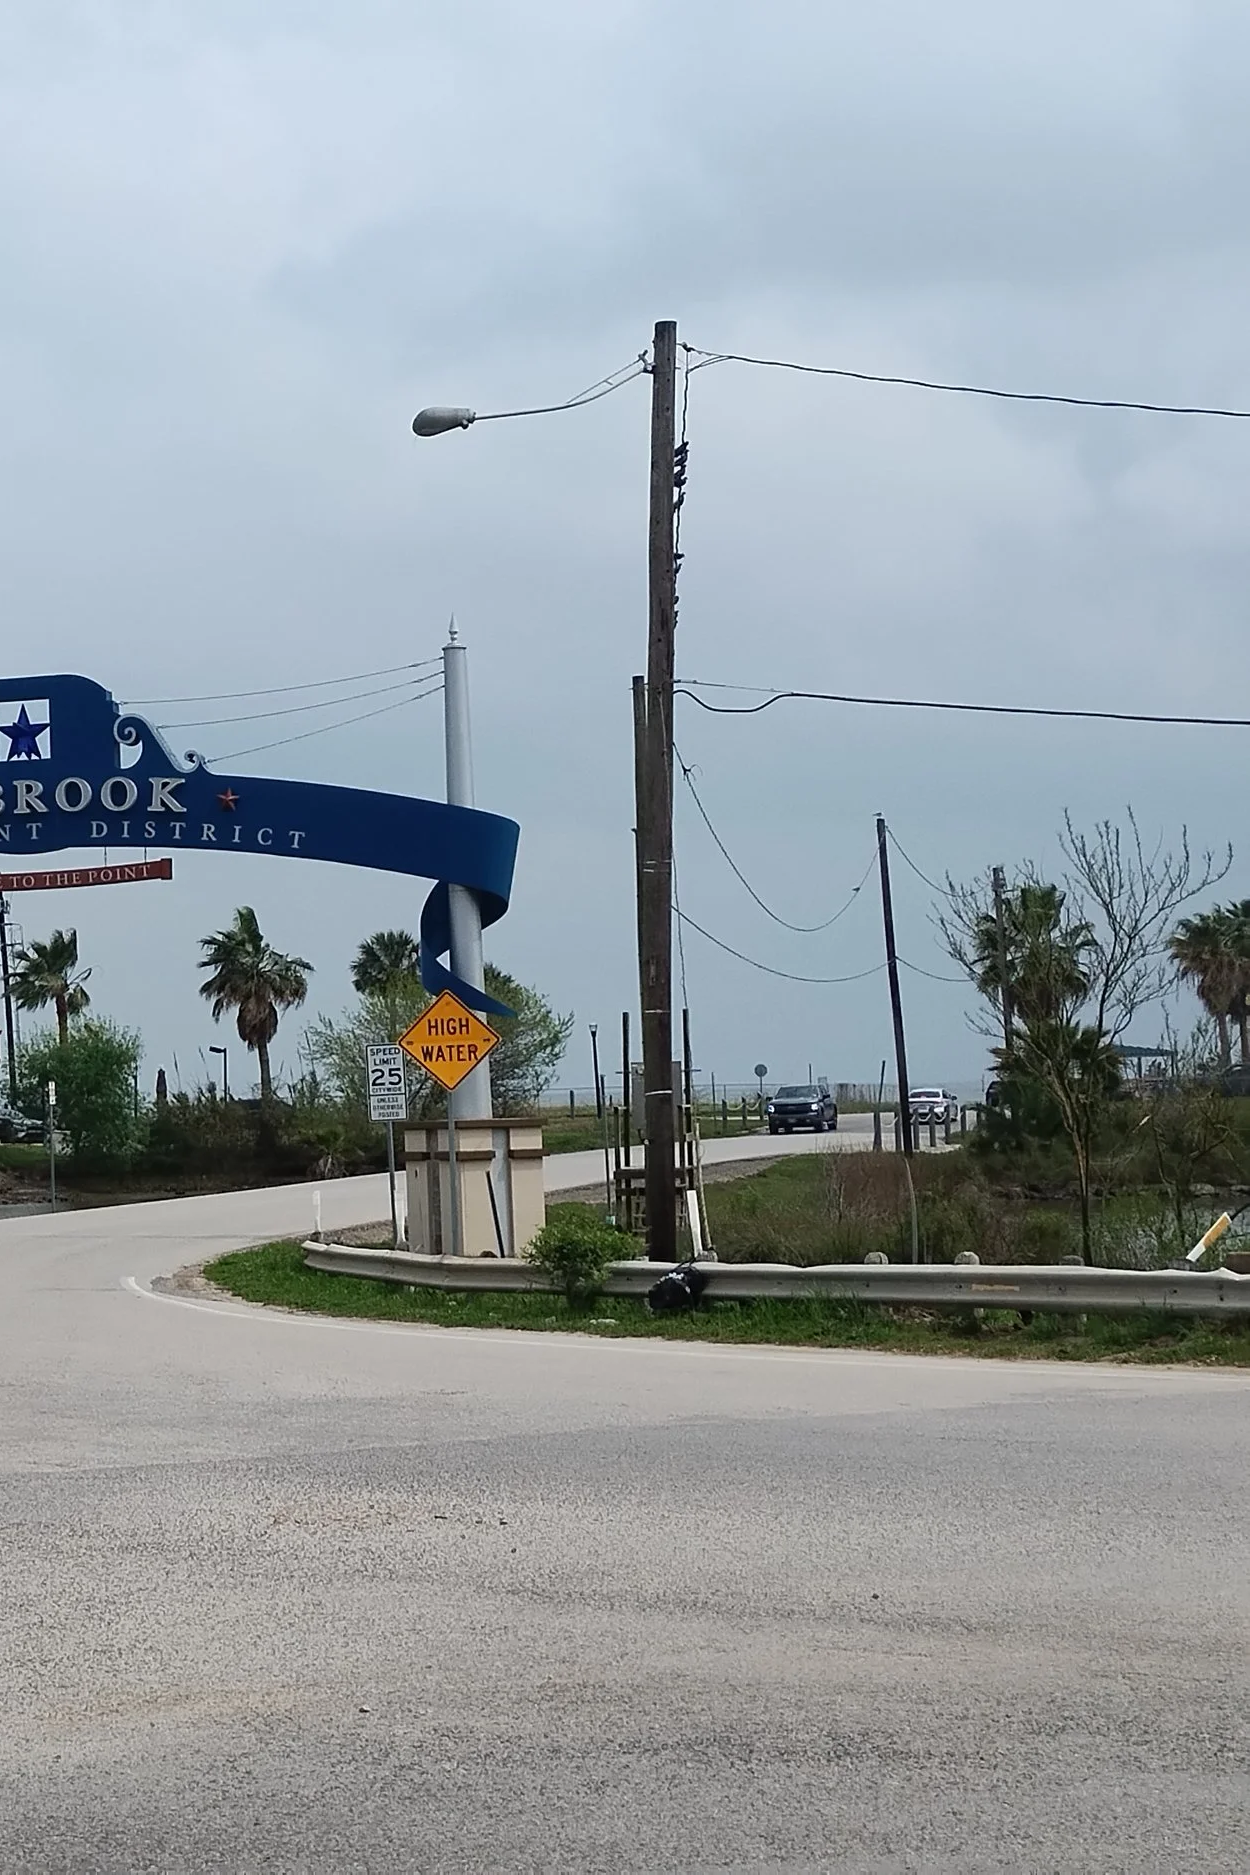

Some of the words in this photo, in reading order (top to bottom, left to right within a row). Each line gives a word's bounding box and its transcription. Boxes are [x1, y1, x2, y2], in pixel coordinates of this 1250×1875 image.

[90, 820, 306, 849] DISTRICT
[9, 875, 35, 888] TO
[43, 872, 81, 887] THE
[88, 865, 151, 883] POINT
[427, 1016, 470, 1036] HIGH
[369, 1047, 401, 1057] SPEED
[373, 1057, 397, 1066] LIMIT
[421, 1043, 479, 1062] WATER
[371, 1067, 403, 1087] 25
